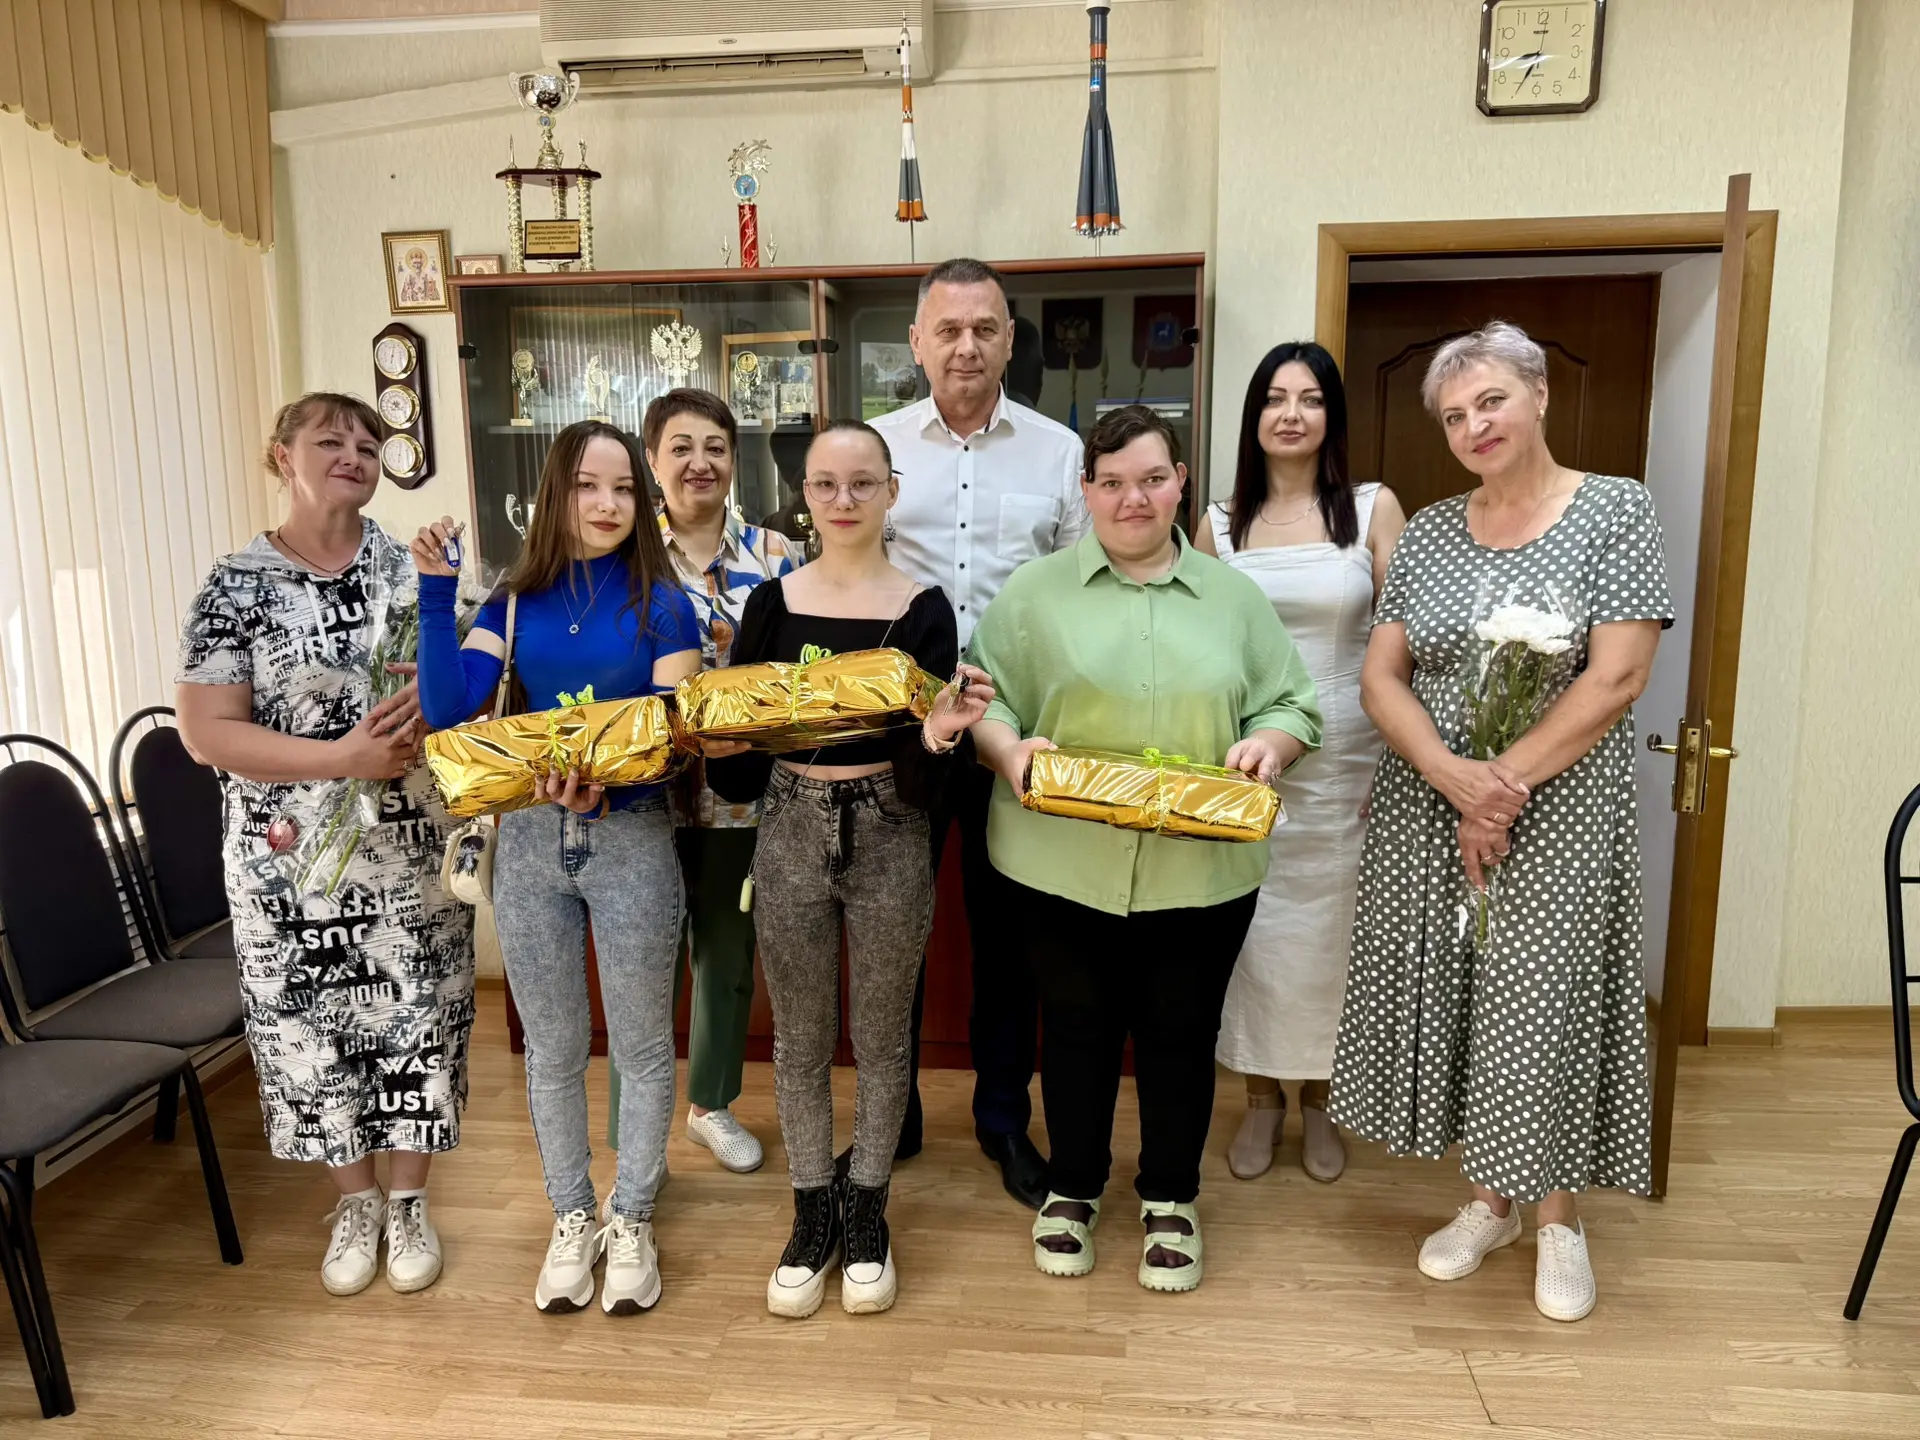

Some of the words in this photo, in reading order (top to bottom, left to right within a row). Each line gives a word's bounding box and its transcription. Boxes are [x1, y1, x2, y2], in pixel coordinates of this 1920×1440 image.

[1537, 10, 1549, 25] 12
[1501, 26, 1516, 40] 10
[1571, 24, 1583, 38] 2
[1500, 47, 1511, 60] 9
[1571, 45, 1581, 59] 3
[1497, 71, 1507, 85] 8
[1568, 67, 1577, 81] 4
[1531, 81, 1542, 95] 6
[1552, 81, 1562, 95] 5
[376, 1054, 443, 1075] WAS
